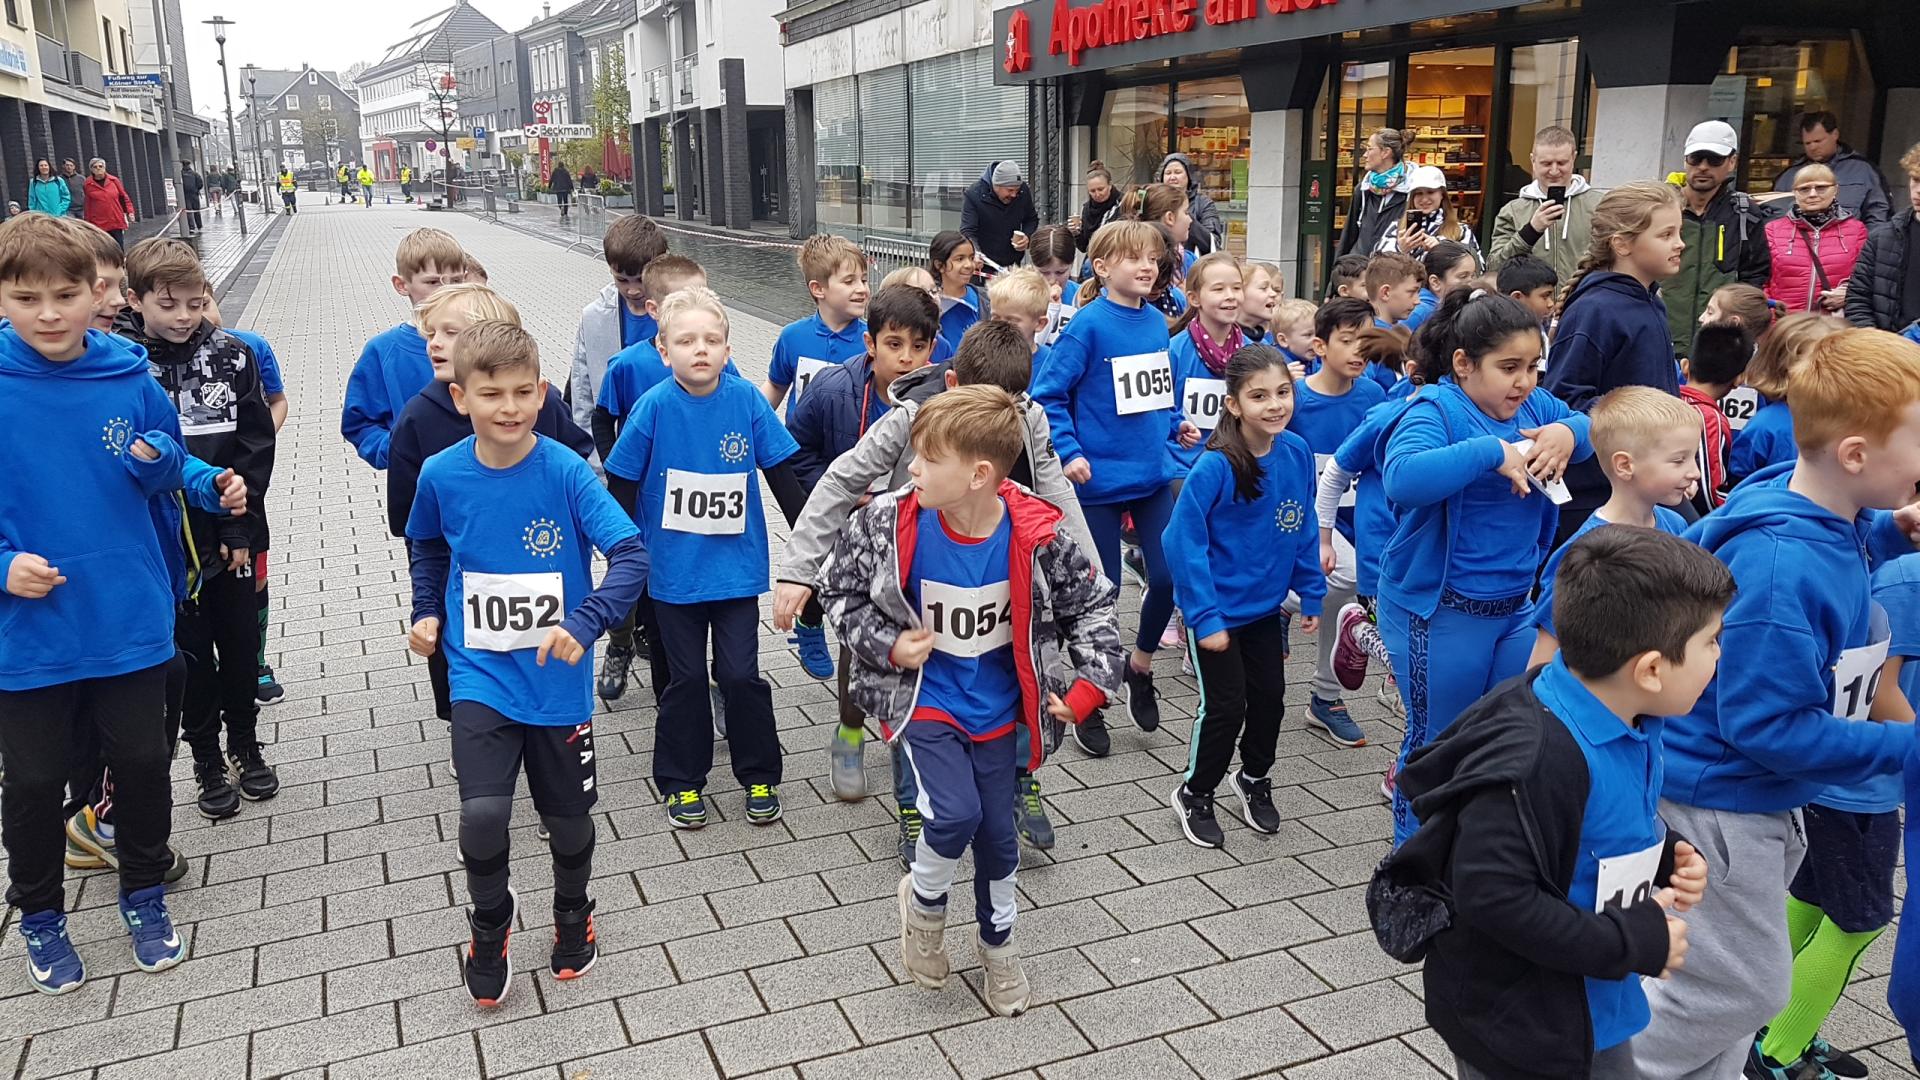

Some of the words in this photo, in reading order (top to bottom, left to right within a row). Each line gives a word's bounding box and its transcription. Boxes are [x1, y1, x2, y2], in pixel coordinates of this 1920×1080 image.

[1048, 0, 1197, 66] Apotheke
[475, 127, 483, 137] P
[540, 125, 592, 136] Beckmann
[1118, 367, 1172, 399] 1055
[670, 487, 744, 520] 1053
[467, 594, 561, 632] 1052
[927, 597, 1012, 641] 1054
